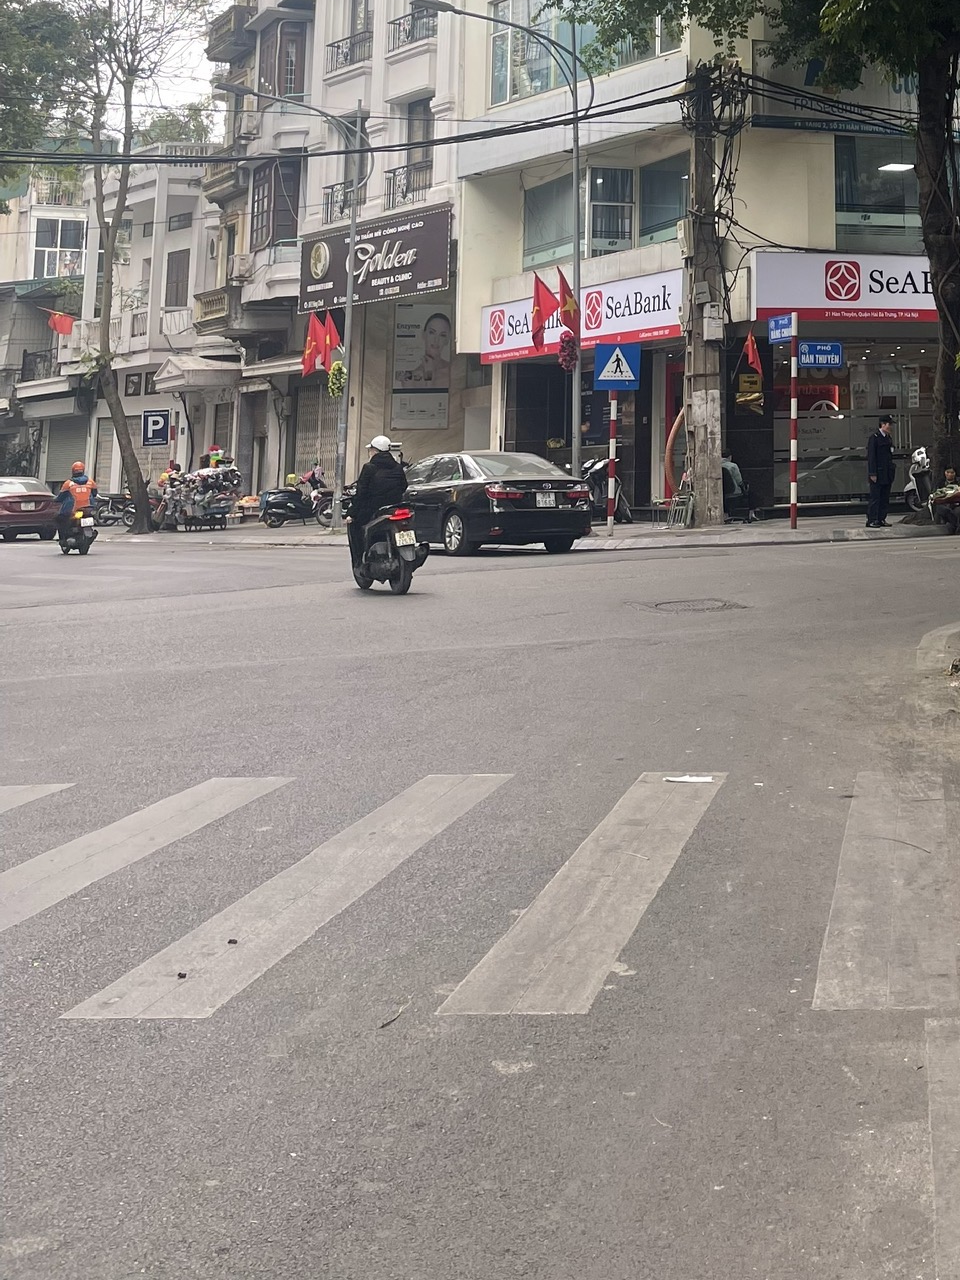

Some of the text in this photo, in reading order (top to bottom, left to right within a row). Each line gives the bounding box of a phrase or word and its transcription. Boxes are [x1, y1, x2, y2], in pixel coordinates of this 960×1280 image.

[411, 221, 424, 229] CAO
[346, 240, 418, 284] Golden
[371, 276, 390, 286] BEAUTY
[605, 285, 672, 320] SeABank
[507, 308, 564, 336] SeAnk
[816, 343, 831, 351] PHỐ
[801, 352, 840, 364] HÀN THUYÊN
[147, 416, 164, 438] P
